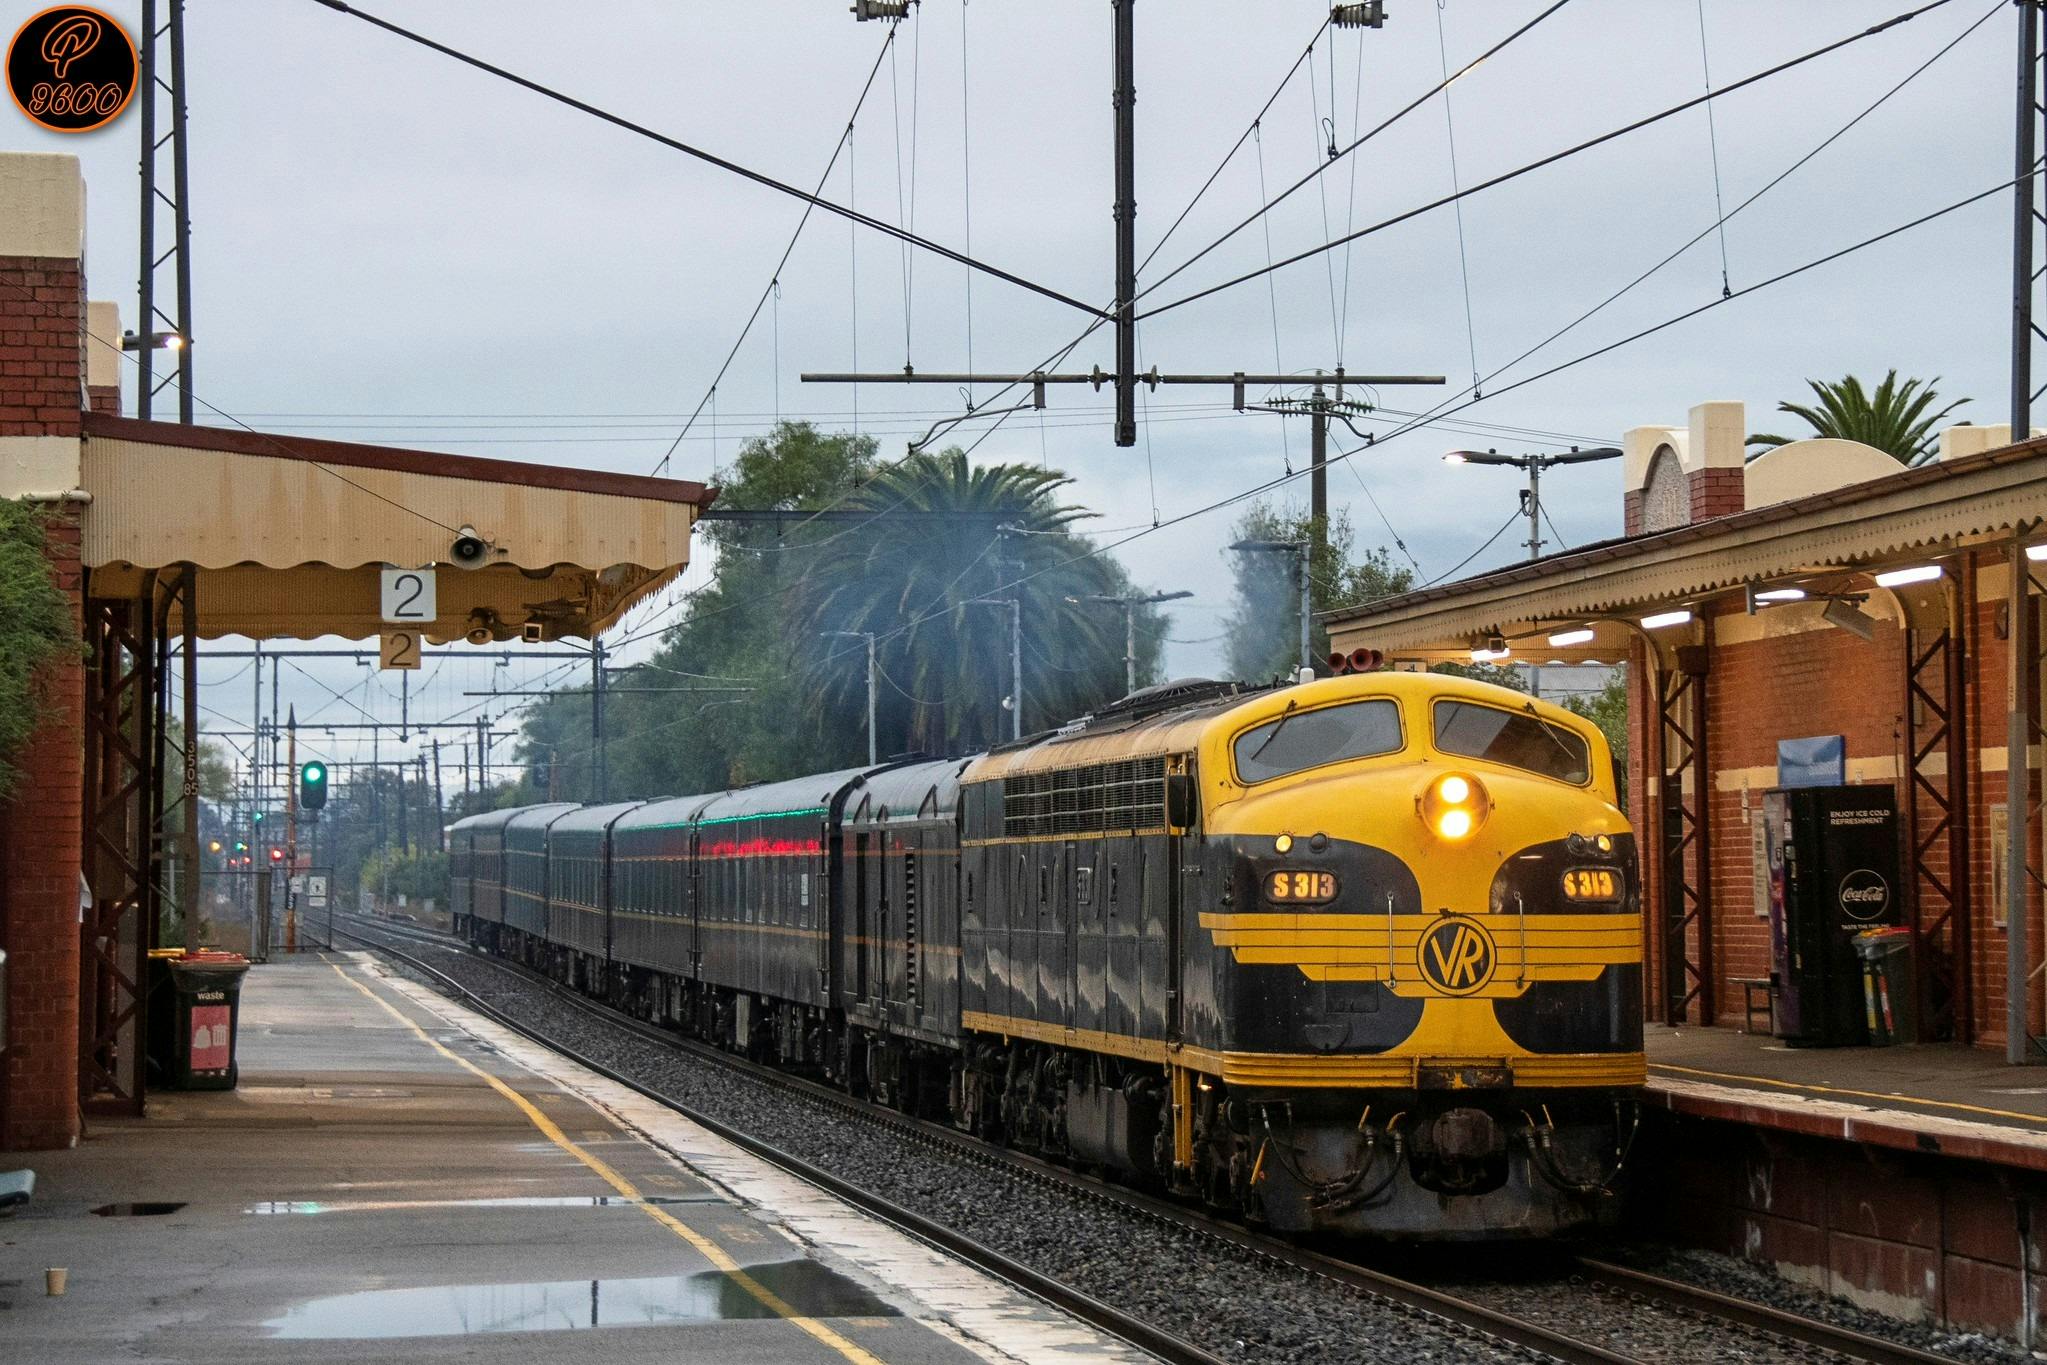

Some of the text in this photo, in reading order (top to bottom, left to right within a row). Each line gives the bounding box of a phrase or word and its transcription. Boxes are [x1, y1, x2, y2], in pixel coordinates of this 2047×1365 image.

[394, 574, 424, 617] 2
[389, 633, 412, 666] 2
[1830, 817, 1883, 825] REFRESHMENT
[1273, 872, 1334, 898] S 313
[1563, 871, 1614, 897] S 313
[1430, 925, 1484, 987] VR
[197, 991, 225, 1000] waste
